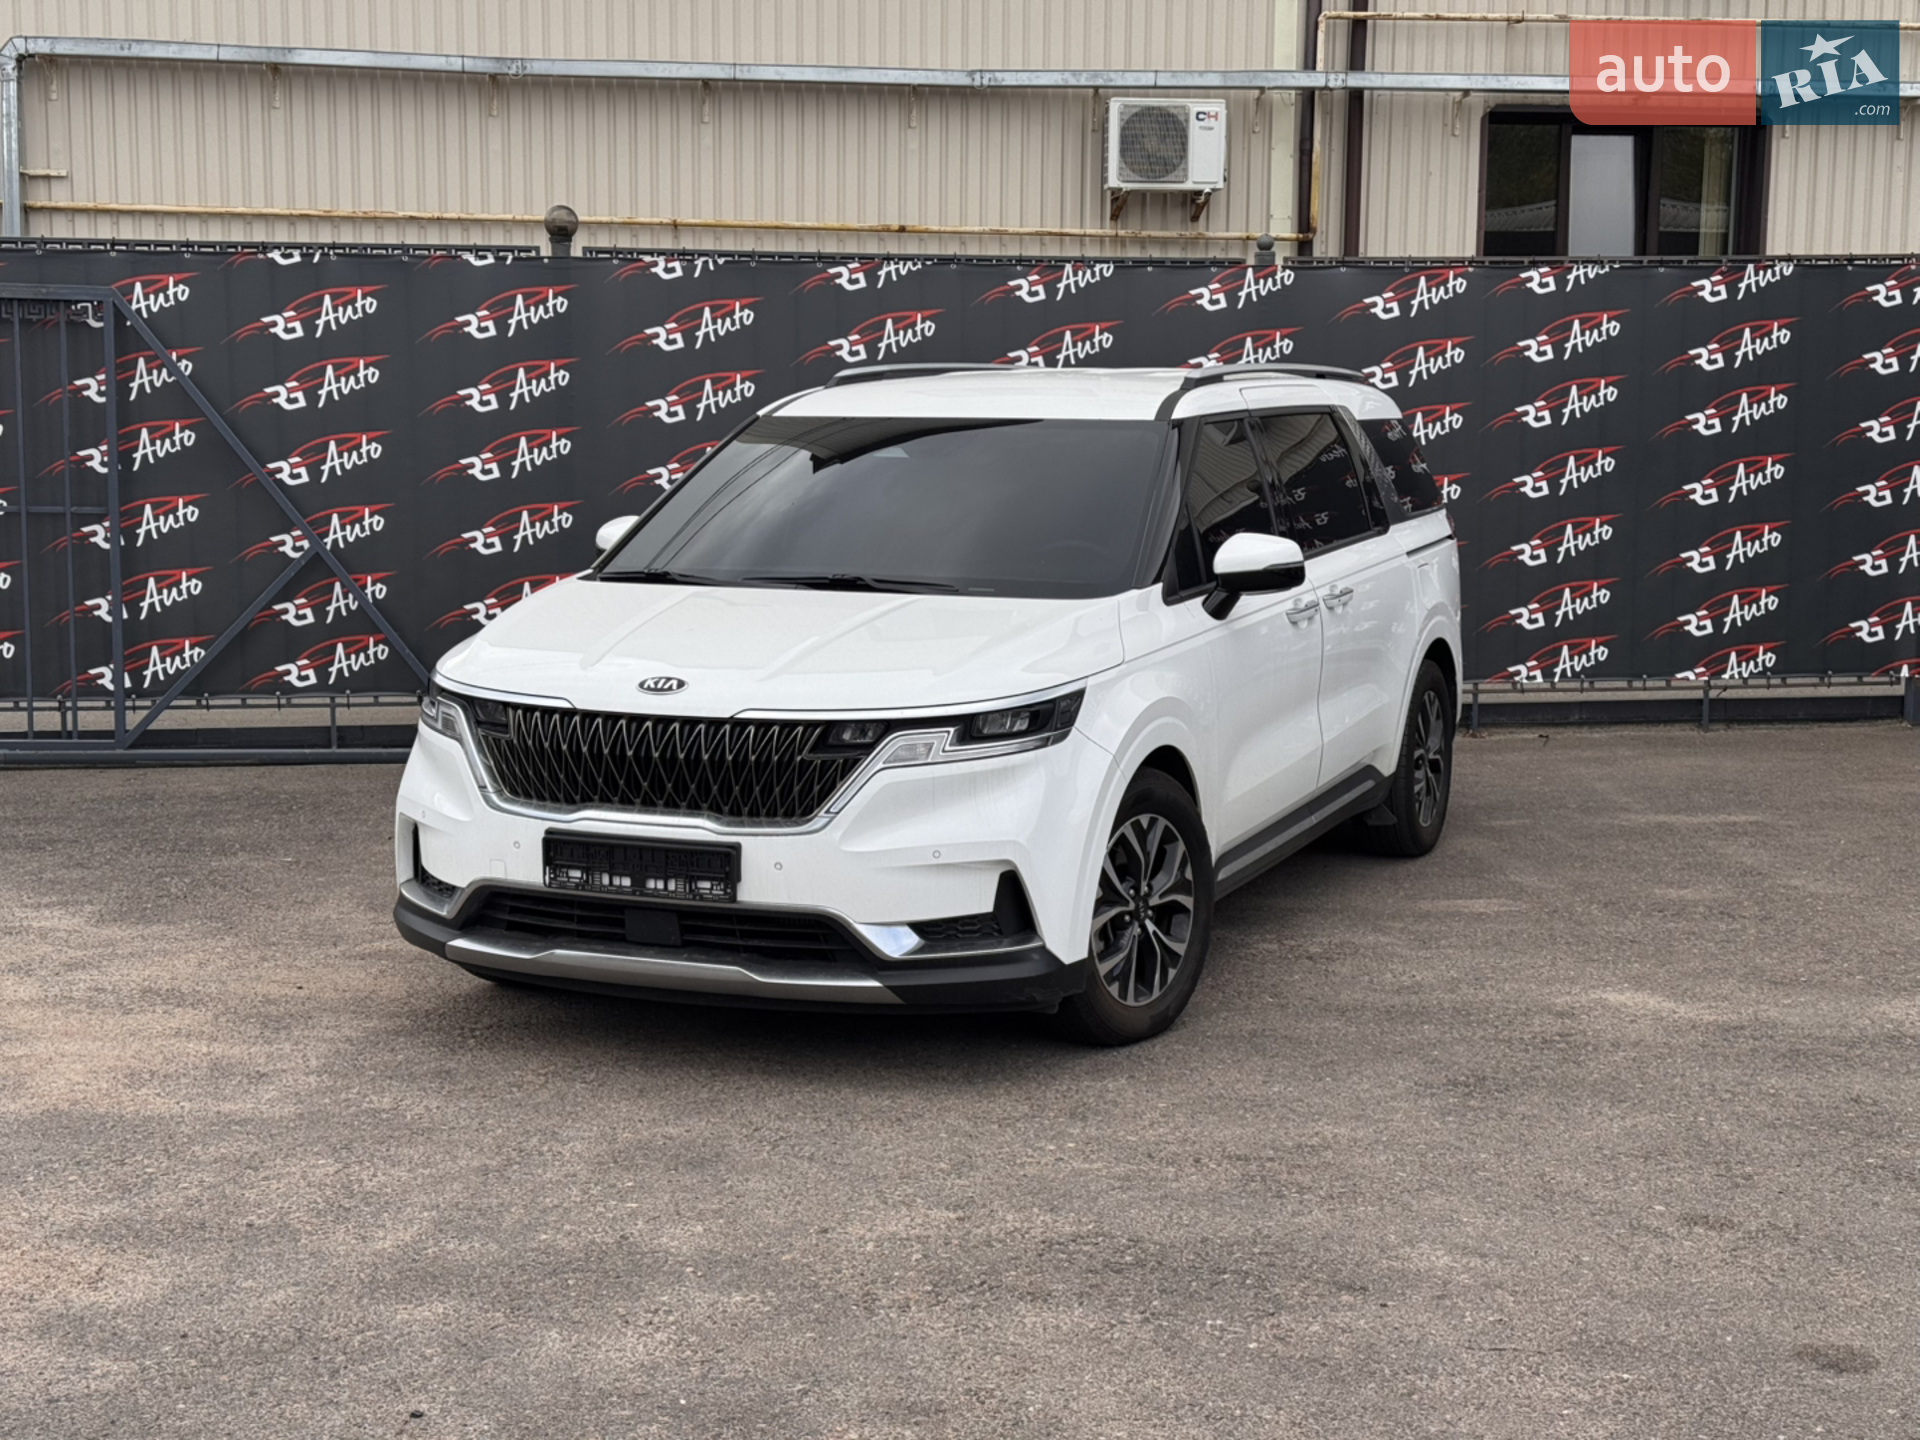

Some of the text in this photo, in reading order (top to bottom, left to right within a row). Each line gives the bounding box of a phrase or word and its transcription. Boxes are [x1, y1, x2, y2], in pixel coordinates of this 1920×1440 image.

[1195, 111, 1219, 122] CH
[1056, 264, 1114, 301] Auto
[1237, 265, 1295, 309] Auto
[1410, 270, 1467, 317] Auto
[1737, 264, 1794, 300] Auto
[315, 288, 377, 338] Auto
[508, 288, 568, 337] Auto
[695, 301, 754, 349] Auto
[877, 313, 935, 360] Auto
[1057, 324, 1113, 368] Auto
[1237, 331, 1294, 364] Auto
[1564, 313, 1621, 360] Auto
[1734, 321, 1791, 368] Auto
[318, 359, 379, 408] Auto
[509, 362, 570, 410] Auto
[1409, 341, 1465, 387] Auto
[696, 373, 755, 421] Auto
[1562, 379, 1618, 425] Auto
[1731, 386, 1788, 433] Auto
[132, 423, 195, 471] Auto
[320, 435, 382, 483] Auto
[511, 431, 571, 480] Auto
[1559, 450, 1615, 495] Auto
[1728, 457, 1784, 503] Auto
[136, 498, 199, 547] Auto
[322, 508, 384, 550] Auto
[513, 505, 573, 552] Auto
[1557, 518, 1612, 563] Auto
[1725, 525, 1781, 570] Auto
[139, 571, 203, 620] Auto
[1555, 582, 1610, 627] Auto
[1723, 588, 1778, 633] Auto
[143, 640, 206, 688] Auto
[328, 637, 389, 684] Auto
[643, 678, 678, 690] KIA
[1553, 639, 1608, 683] Auto
[1721, 645, 1776, 679] Auto
